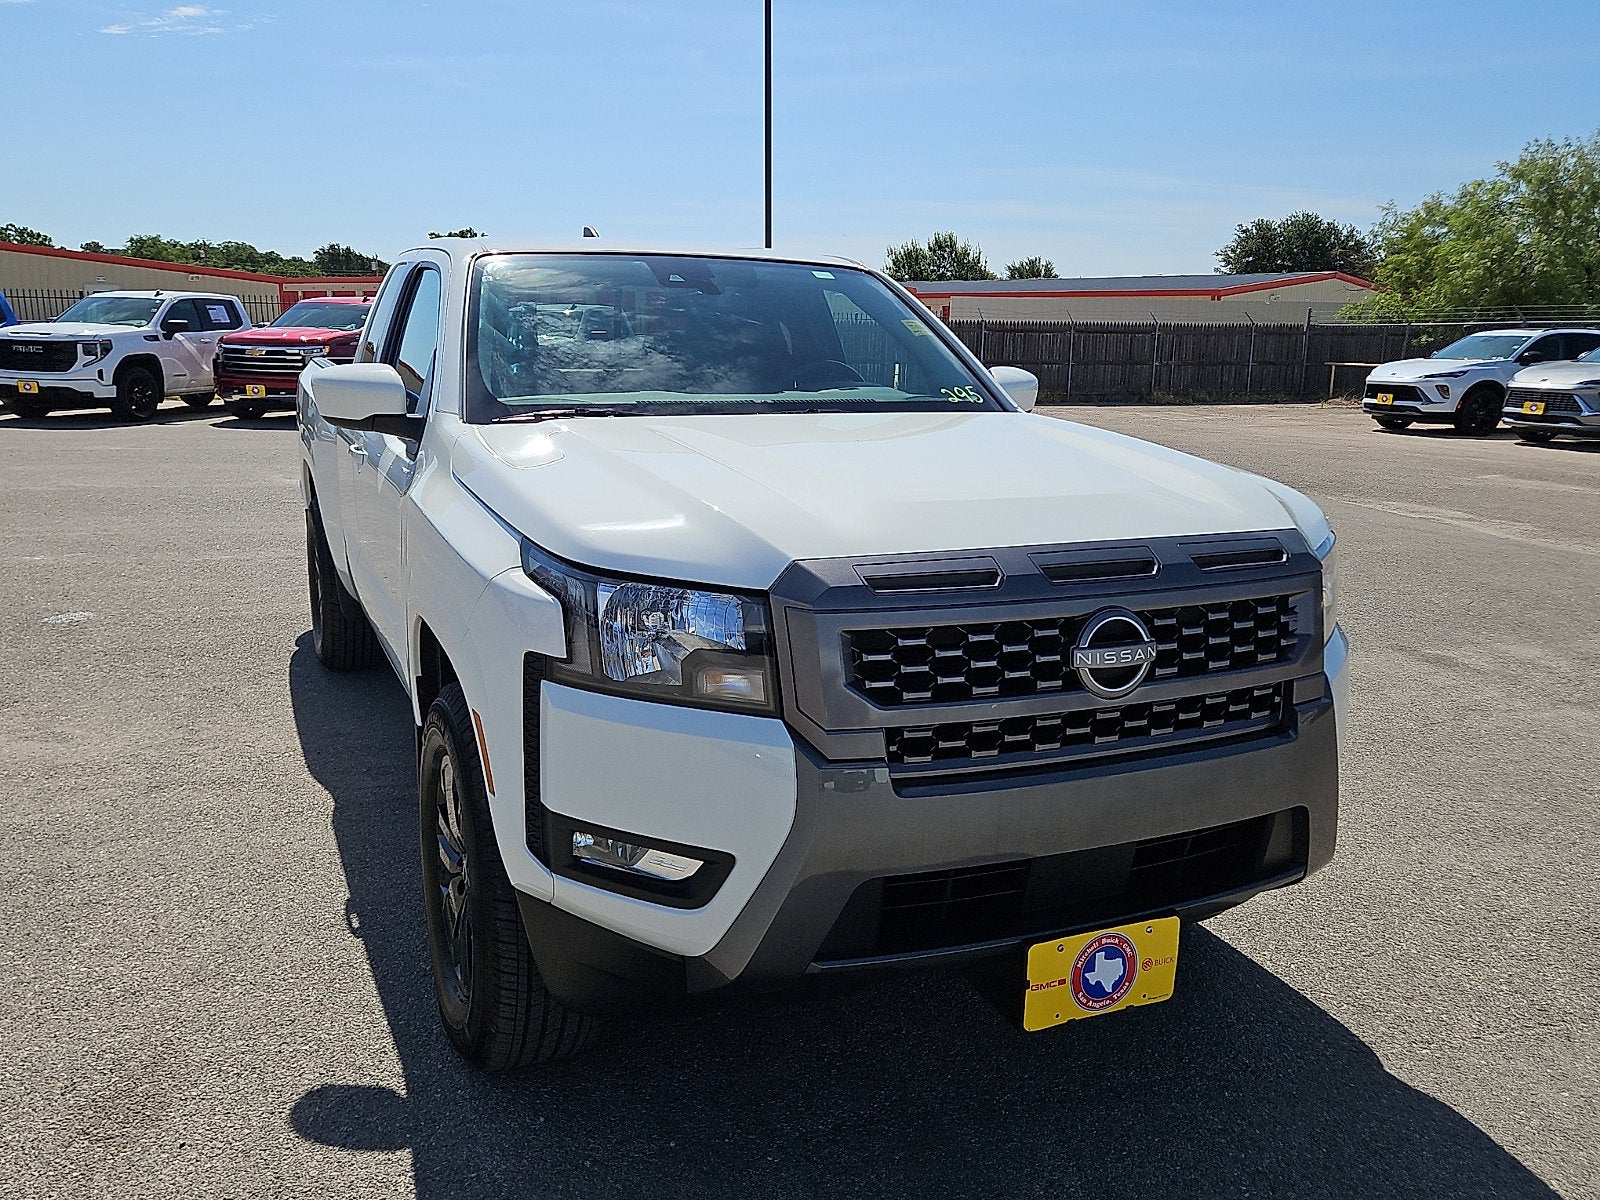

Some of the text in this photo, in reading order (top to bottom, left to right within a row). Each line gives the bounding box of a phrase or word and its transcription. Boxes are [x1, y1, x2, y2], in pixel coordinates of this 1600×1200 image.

[940, 386, 984, 404] 295
[1076, 645, 1156, 665] NISSAN
[1076, 941, 1100, 968] Mitchell
[1101, 937, 1120, 945] Buick
[1122, 942, 1133, 958] GMC
[1154, 956, 1174, 966] BUICK
[1030, 980, 1058, 991] GMC
[1077, 991, 1088, 1004] San
[1112, 981, 1130, 1000] Texas
